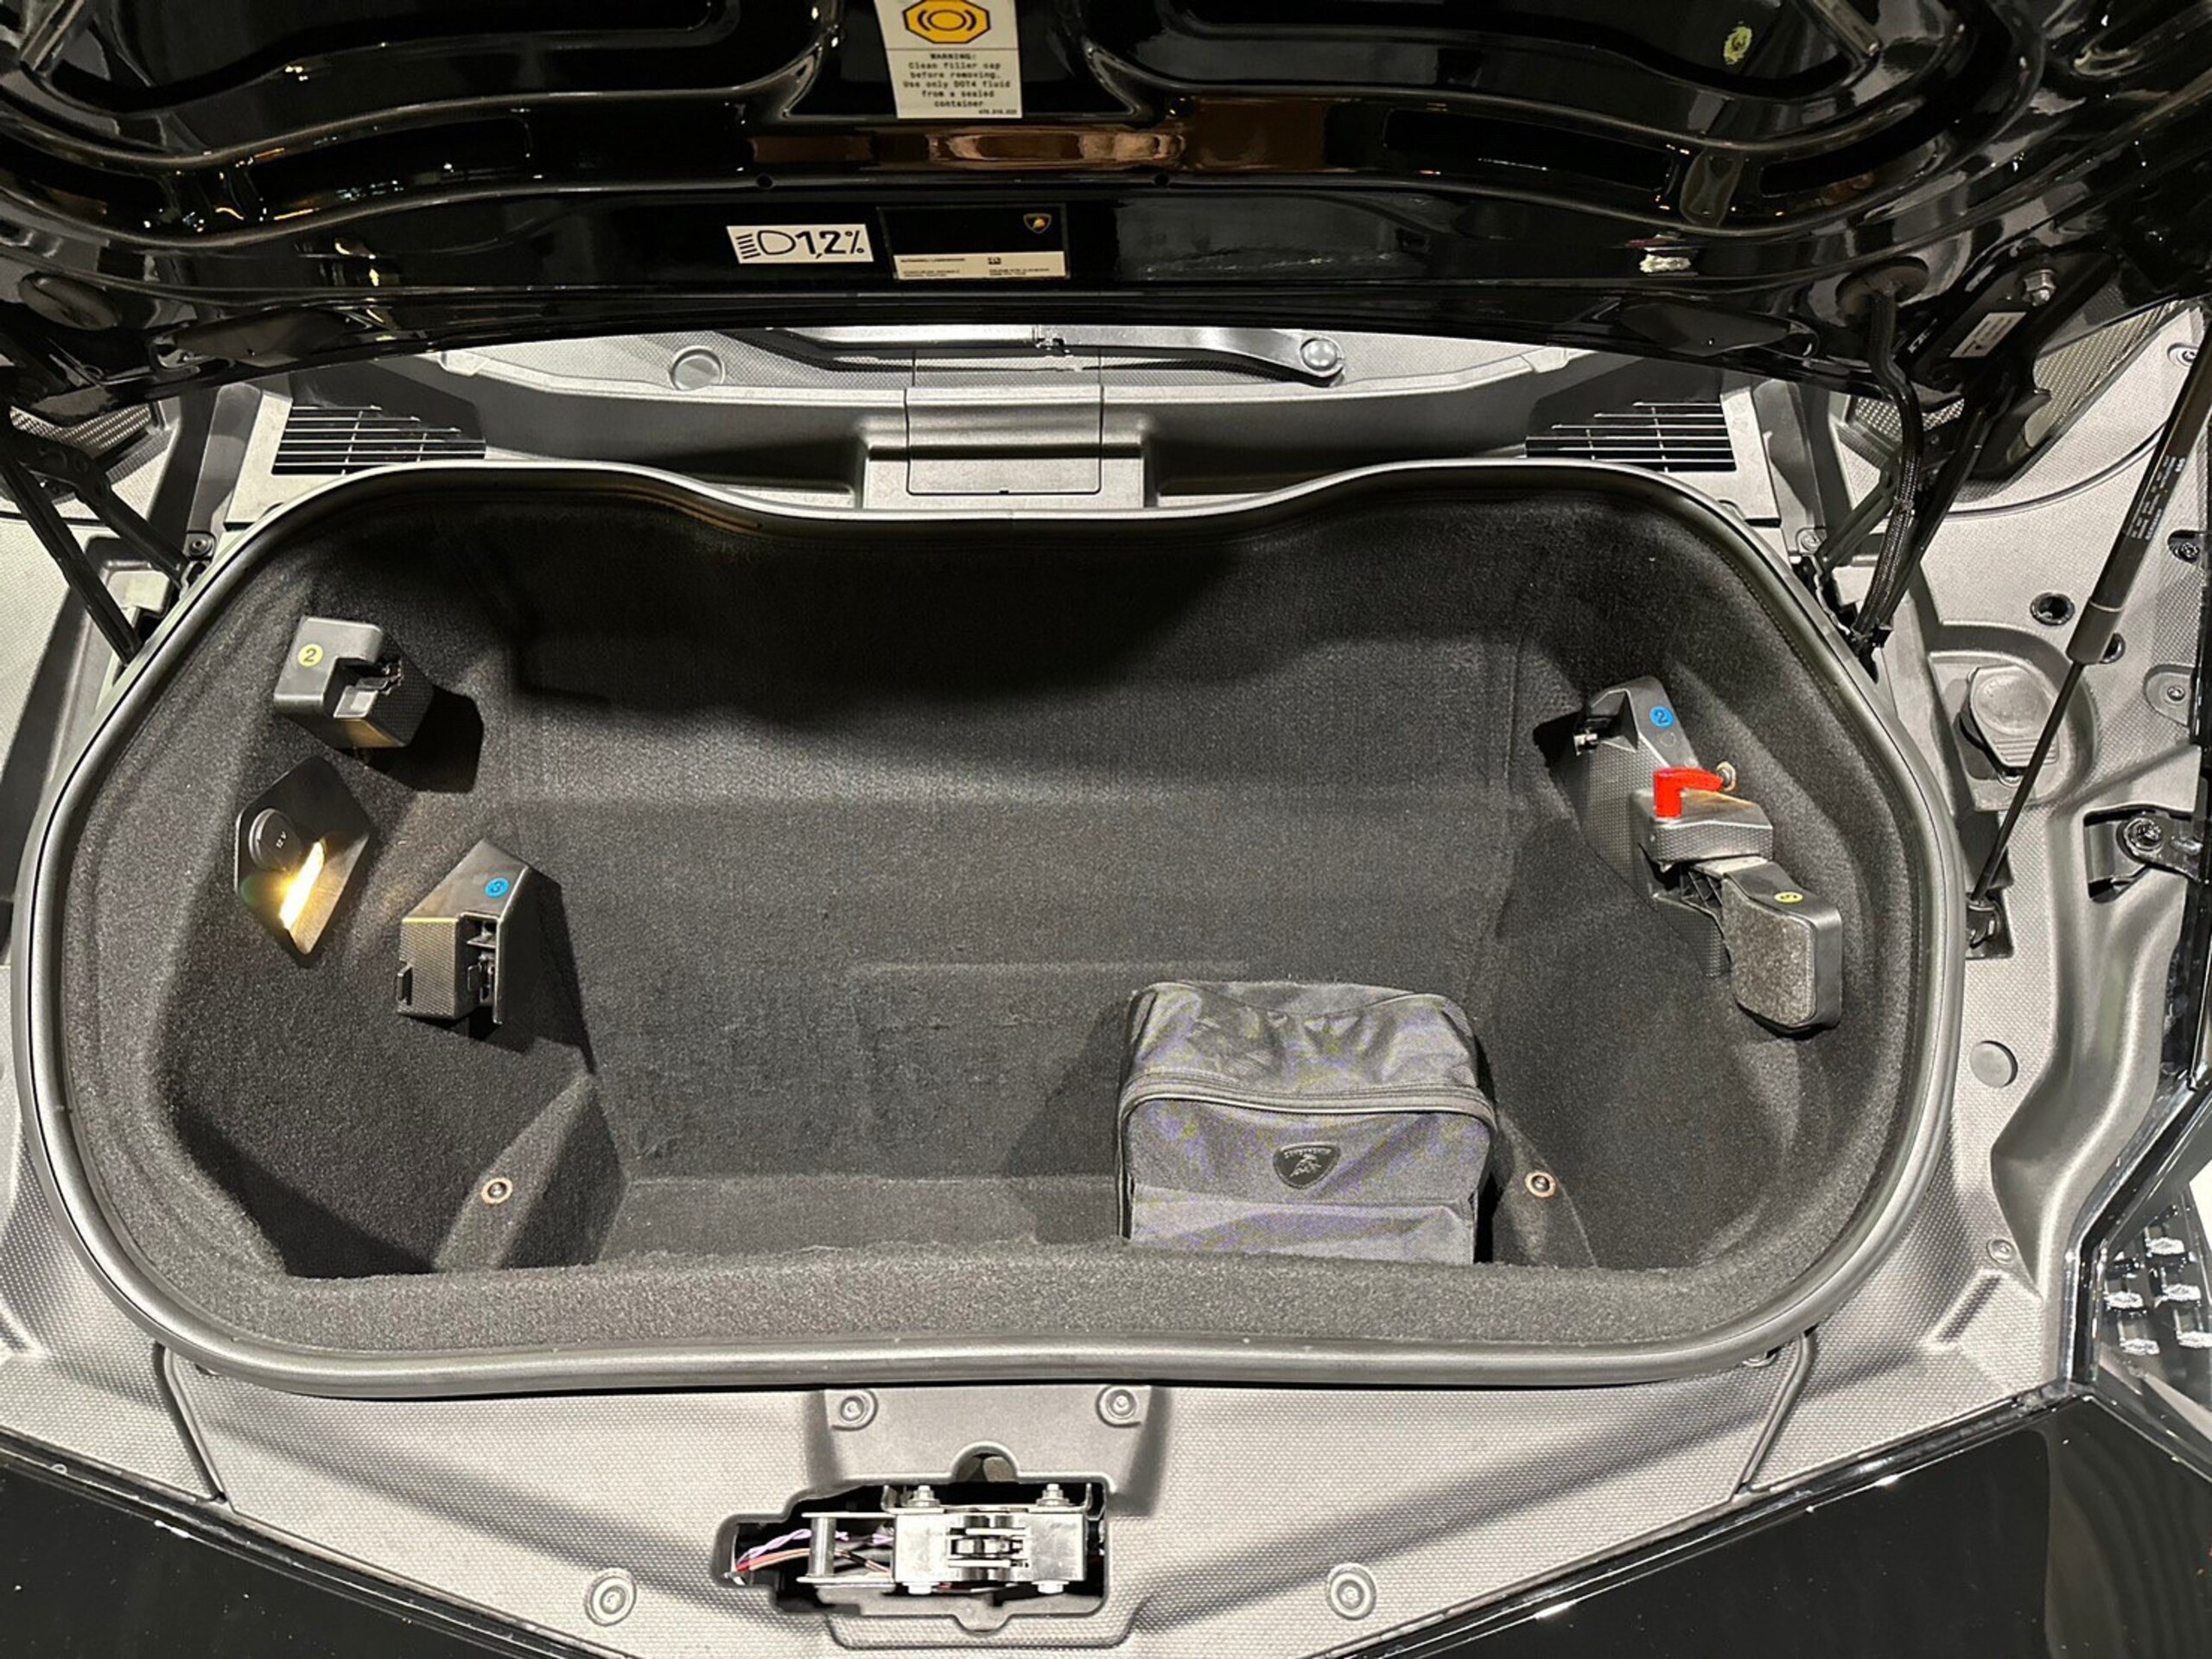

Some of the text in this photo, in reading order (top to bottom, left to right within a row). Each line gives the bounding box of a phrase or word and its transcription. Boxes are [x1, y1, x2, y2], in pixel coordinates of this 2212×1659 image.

[982, 62, 1001, 71] cap
[925, 79, 948, 90] only
[953, 79, 976, 88] DOT4
[982, 79, 1010, 88] fluid
[795, 230, 865, 259] 1,2%
[302, 646, 317, 663] 2
[1654, 709, 1669, 724] 2
